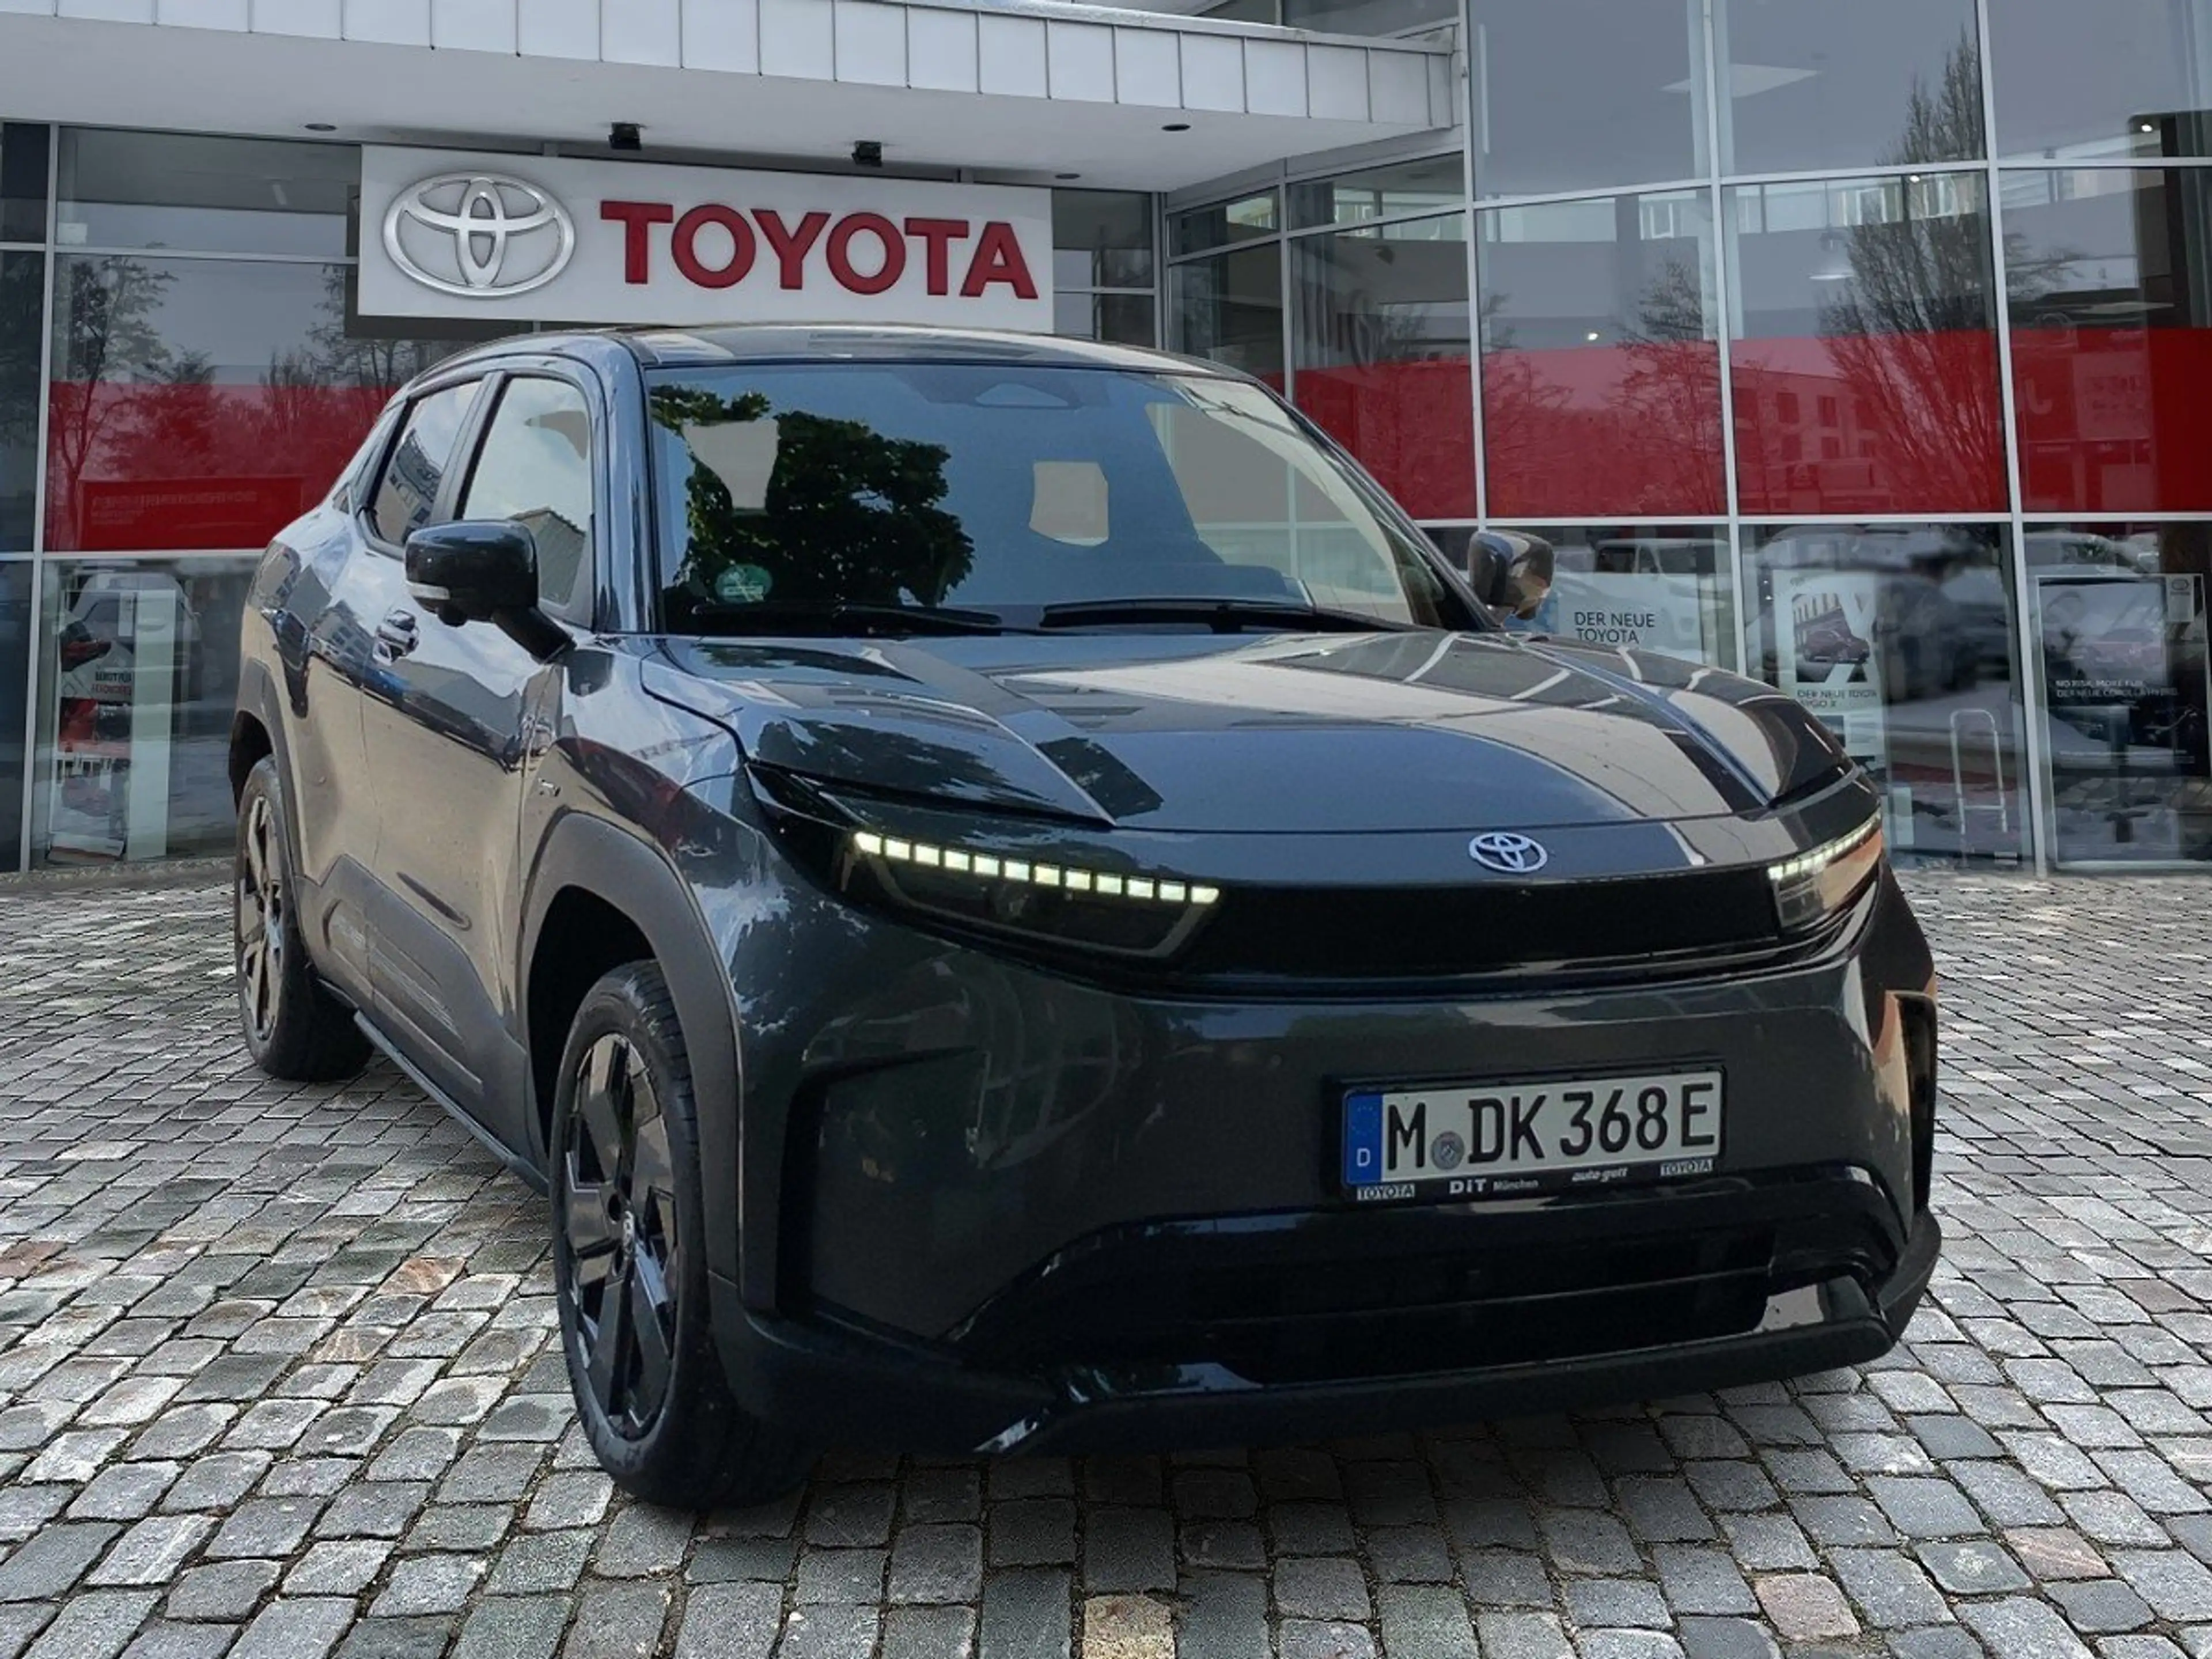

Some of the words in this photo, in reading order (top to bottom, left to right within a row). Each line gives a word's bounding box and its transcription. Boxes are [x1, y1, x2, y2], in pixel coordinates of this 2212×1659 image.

[600, 199, 1039, 300] TOYOTA
[1574, 612, 1607, 626] DER
[1611, 613, 1656, 628] NEUE
[1575, 628, 1639, 644] TOYOTA
[1388, 1102, 1426, 1171] M
[1468, 1094, 1547, 1164] DK
[1357, 1148, 1370, 1166] D
[1660, 1159, 1713, 1177] TOYOTA
[1357, 1184, 1415, 1200] TOYOTA
